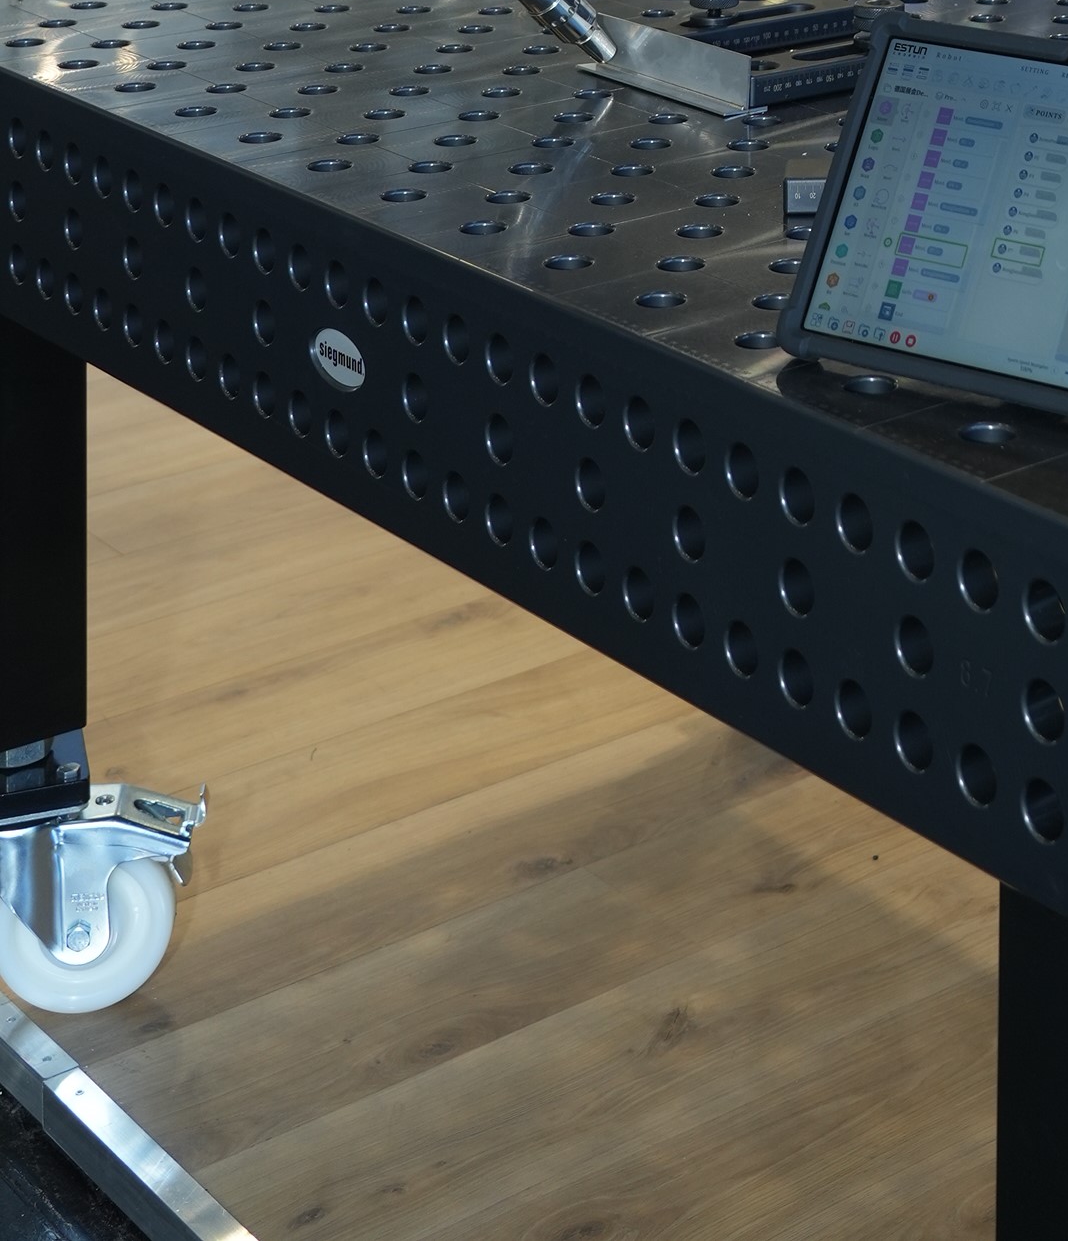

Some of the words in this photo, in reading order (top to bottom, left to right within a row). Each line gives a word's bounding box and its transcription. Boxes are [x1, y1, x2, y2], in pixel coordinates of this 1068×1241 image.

[893, 42, 928, 56] ESTUN
[936, 52, 963, 62] Robot
[1020, 65, 1049, 76] SETTING
[1035, 109, 1063, 120] POINTS
[319, 341, 363, 375] siegmund
